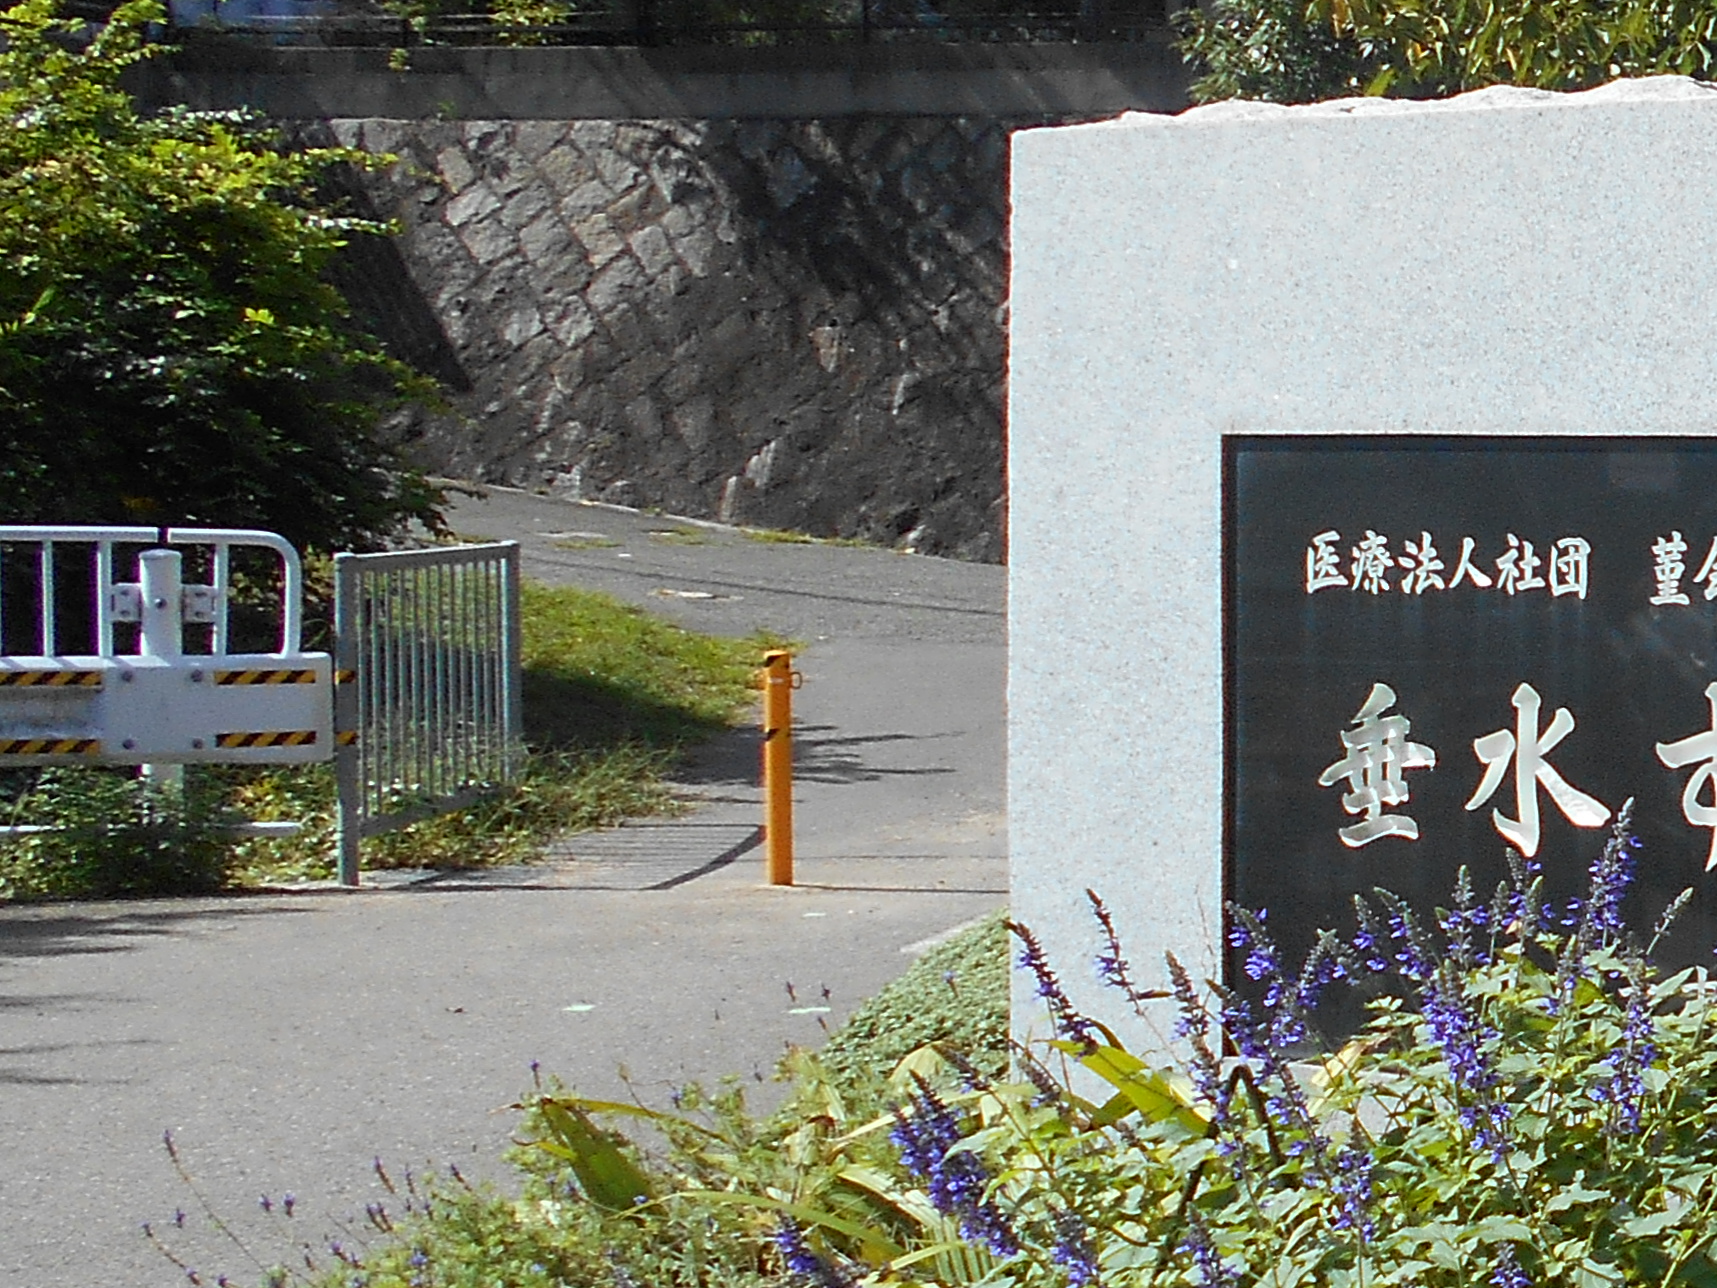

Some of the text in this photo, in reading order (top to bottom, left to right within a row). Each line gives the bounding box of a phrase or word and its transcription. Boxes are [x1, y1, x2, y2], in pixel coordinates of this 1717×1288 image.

[1305, 530, 1592, 599] 医療法人社団
